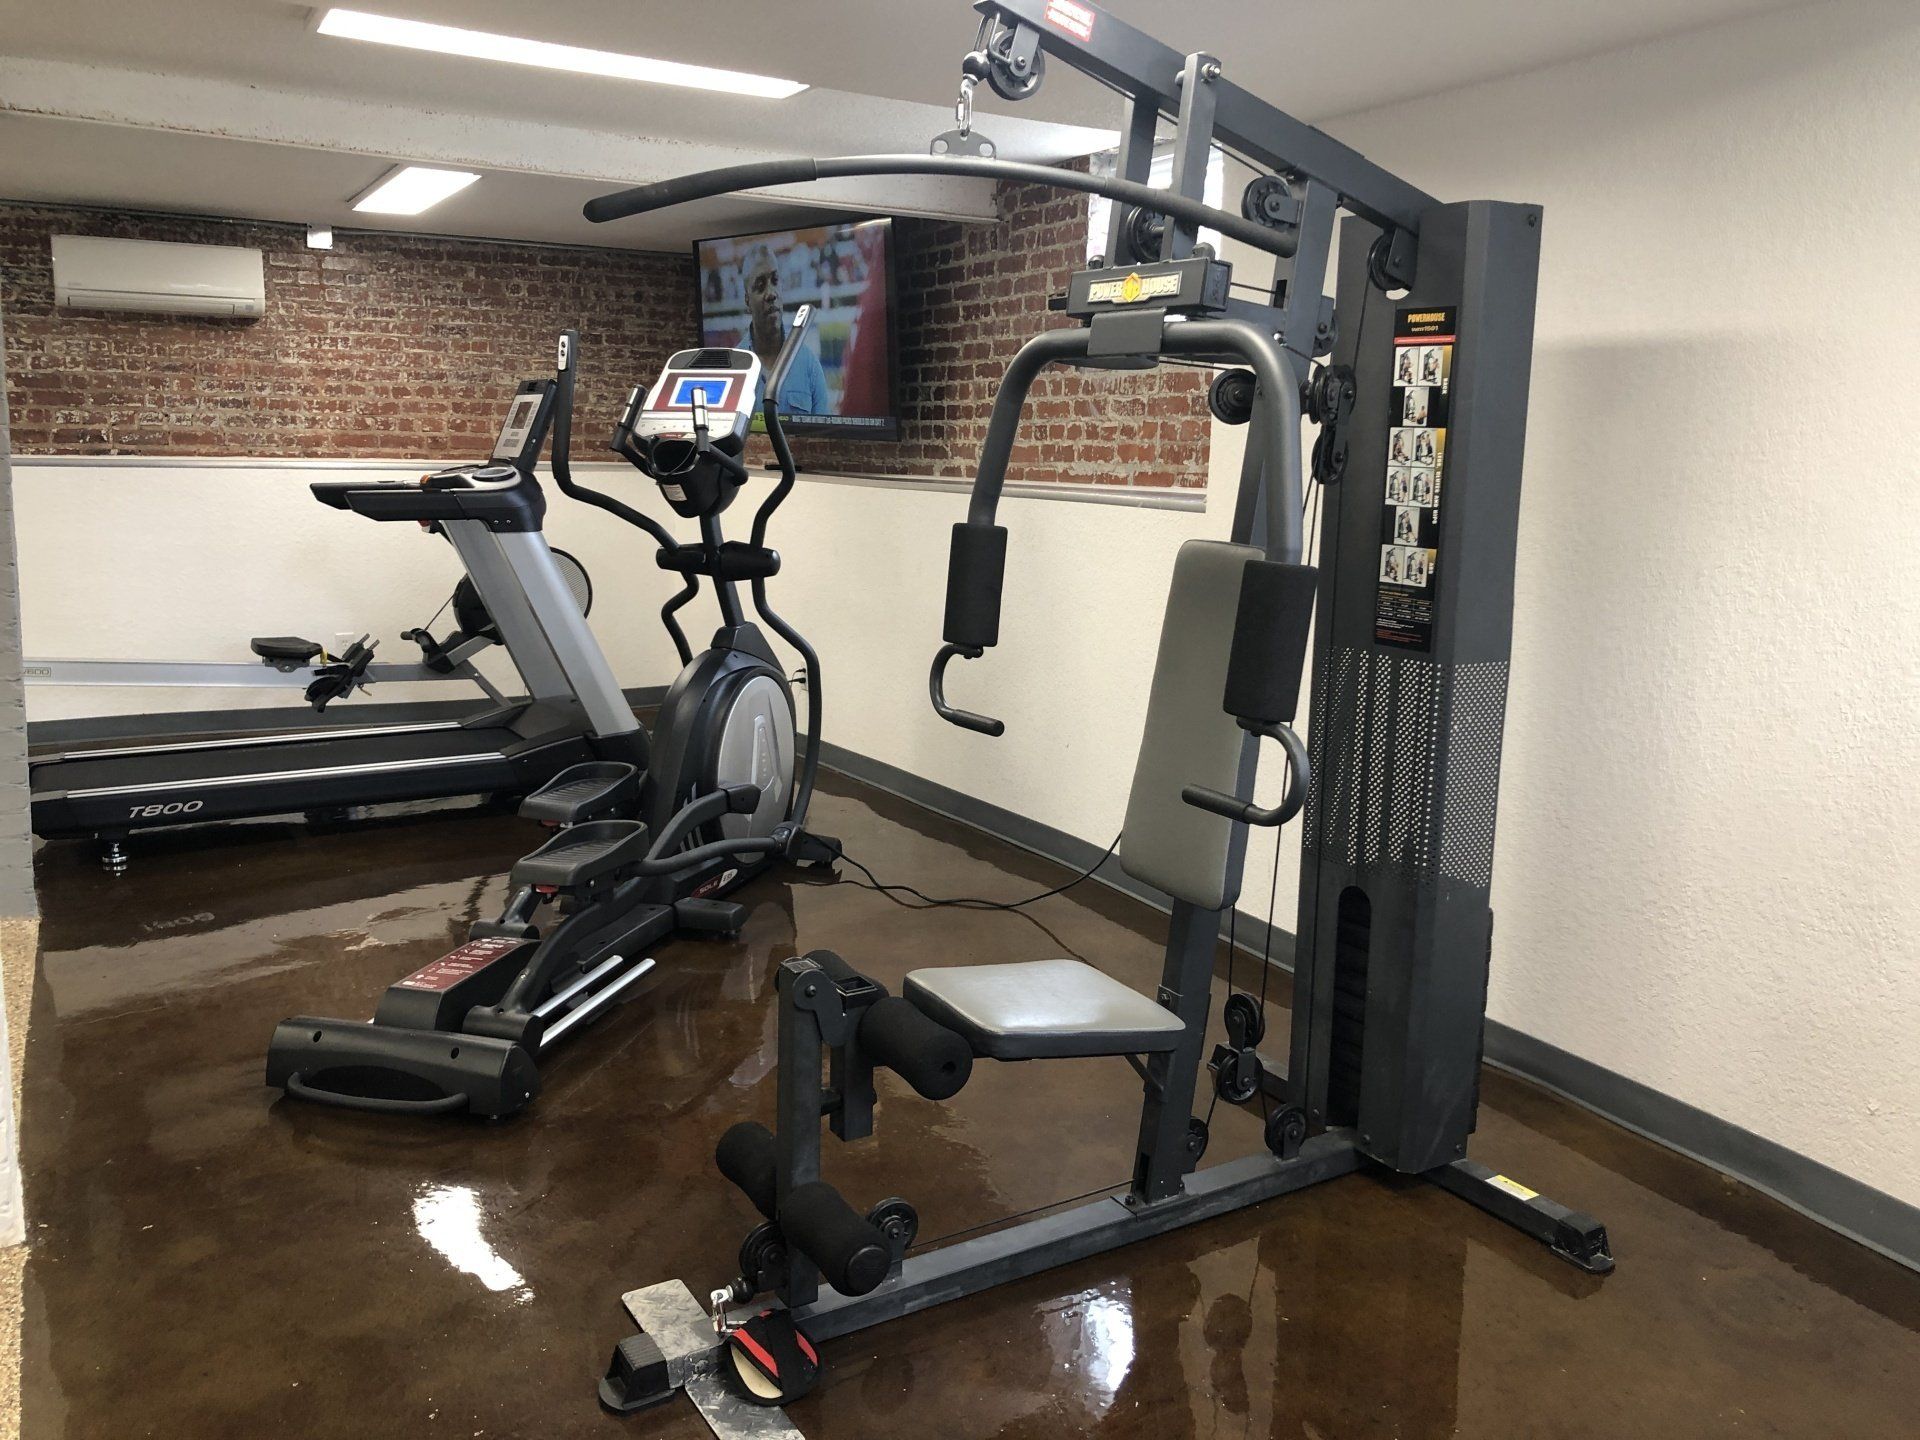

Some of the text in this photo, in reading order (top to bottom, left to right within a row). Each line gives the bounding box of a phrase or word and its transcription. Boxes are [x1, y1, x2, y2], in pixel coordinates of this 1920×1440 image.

[1141, 275, 1178, 295] HOUSE
[1407, 312, 1445, 323] POWERHOUSE
[129, 800, 203, 818] T800
